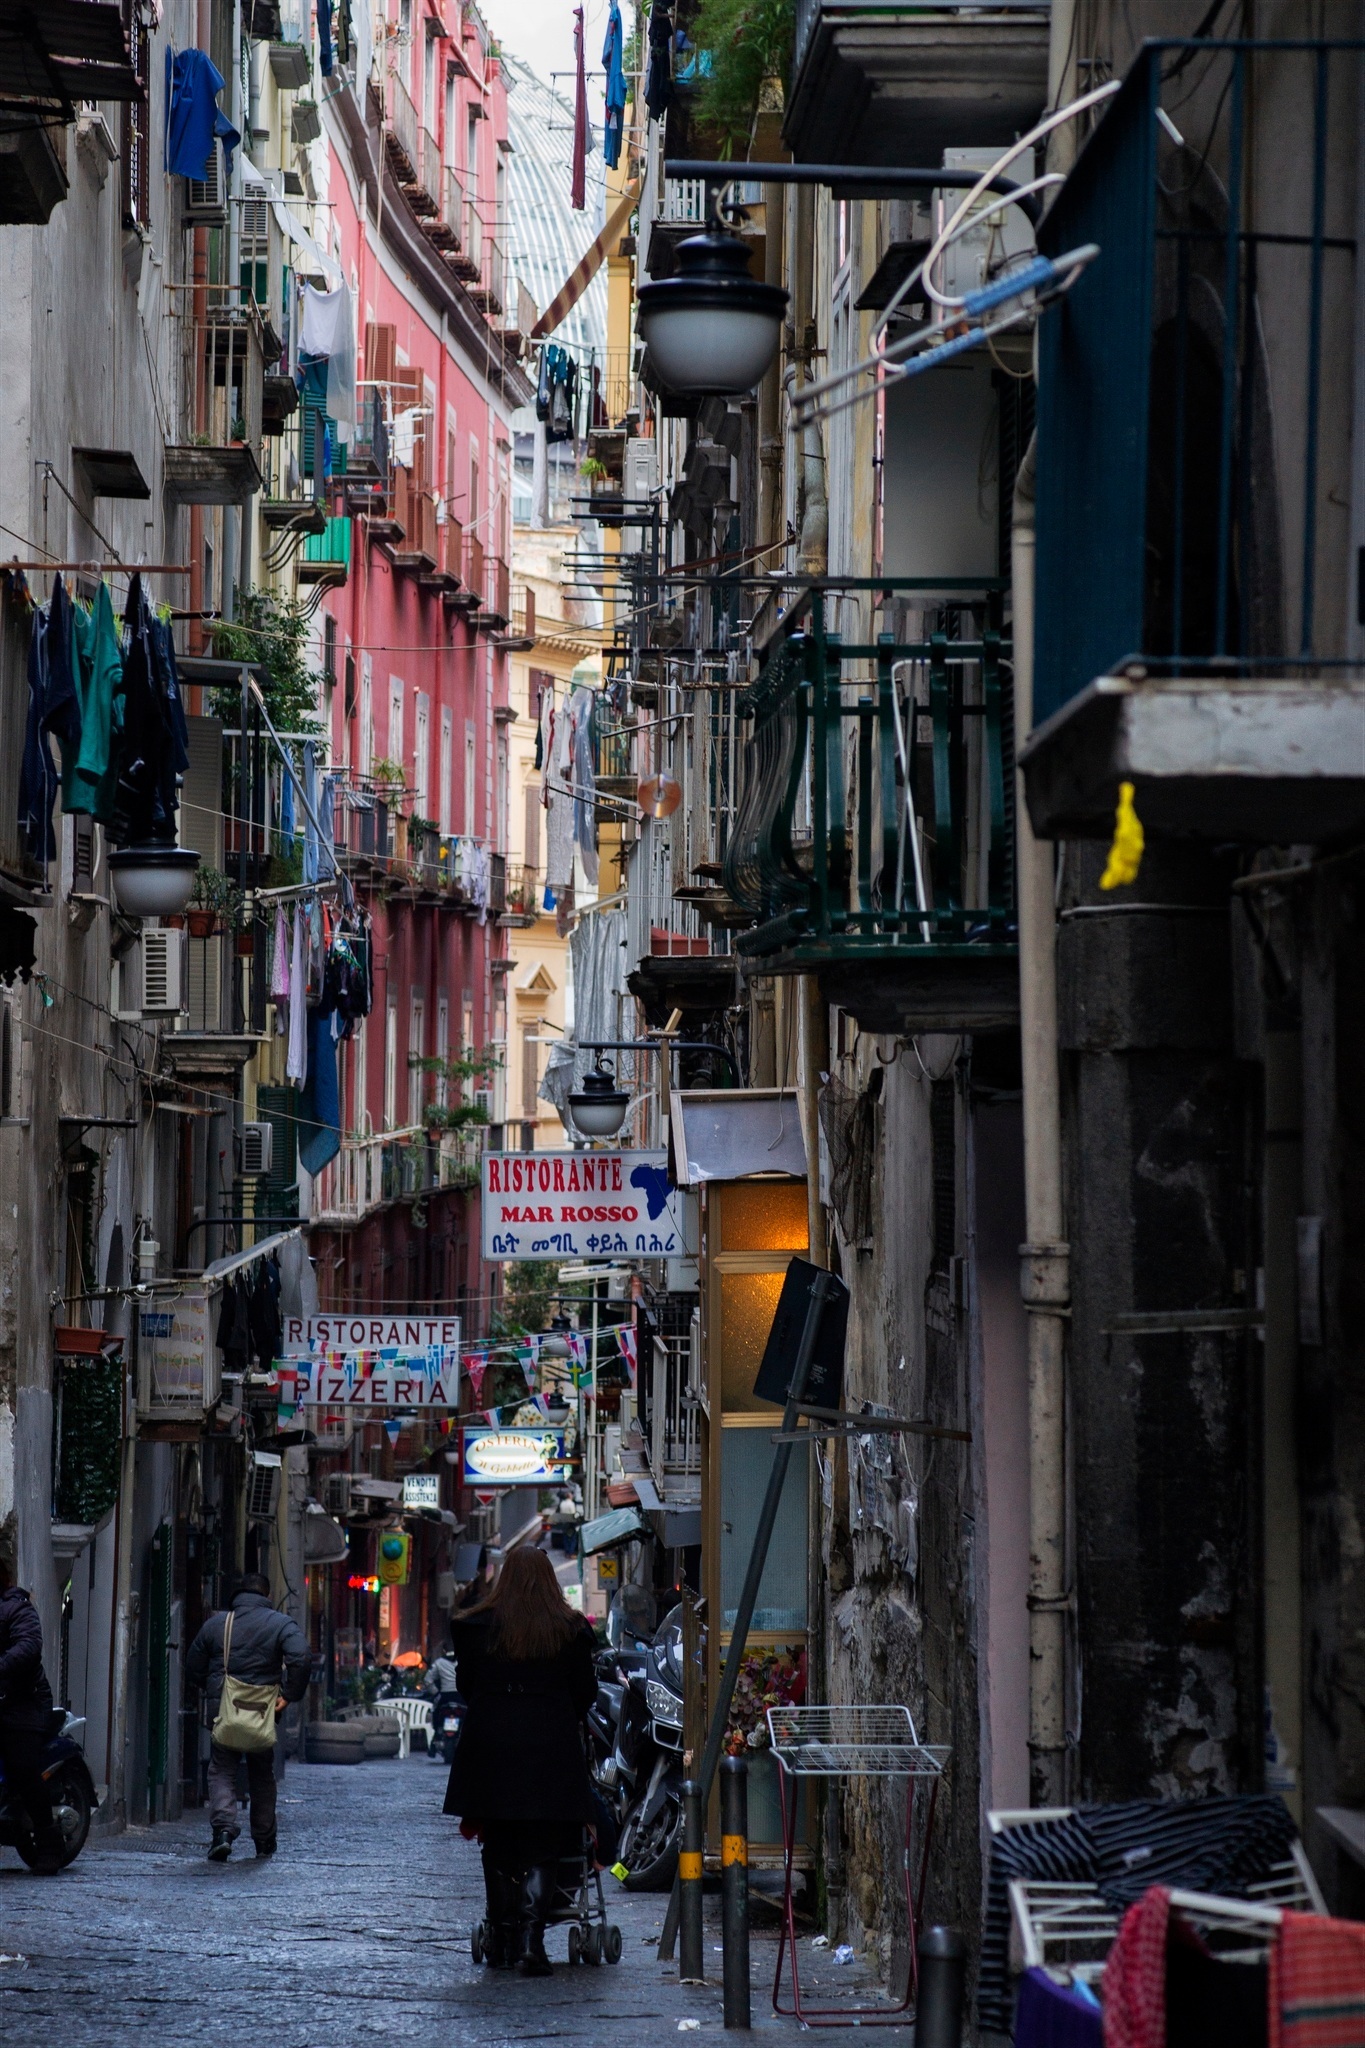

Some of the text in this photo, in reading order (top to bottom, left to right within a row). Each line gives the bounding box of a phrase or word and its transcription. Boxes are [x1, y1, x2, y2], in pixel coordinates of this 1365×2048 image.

[488, 1157, 624, 1193] RISTORANTE
[501, 1205, 639, 1223] MAR ROSSO
[289, 1320, 456, 1345] RISTORANTE
[293, 1378, 448, 1404] PIZZERIA
[475, 1435, 539, 1453] OSTERIA
[407, 1477, 437, 1488] VENDITA
[405, 1492, 437, 1502] ASSISTENZA
